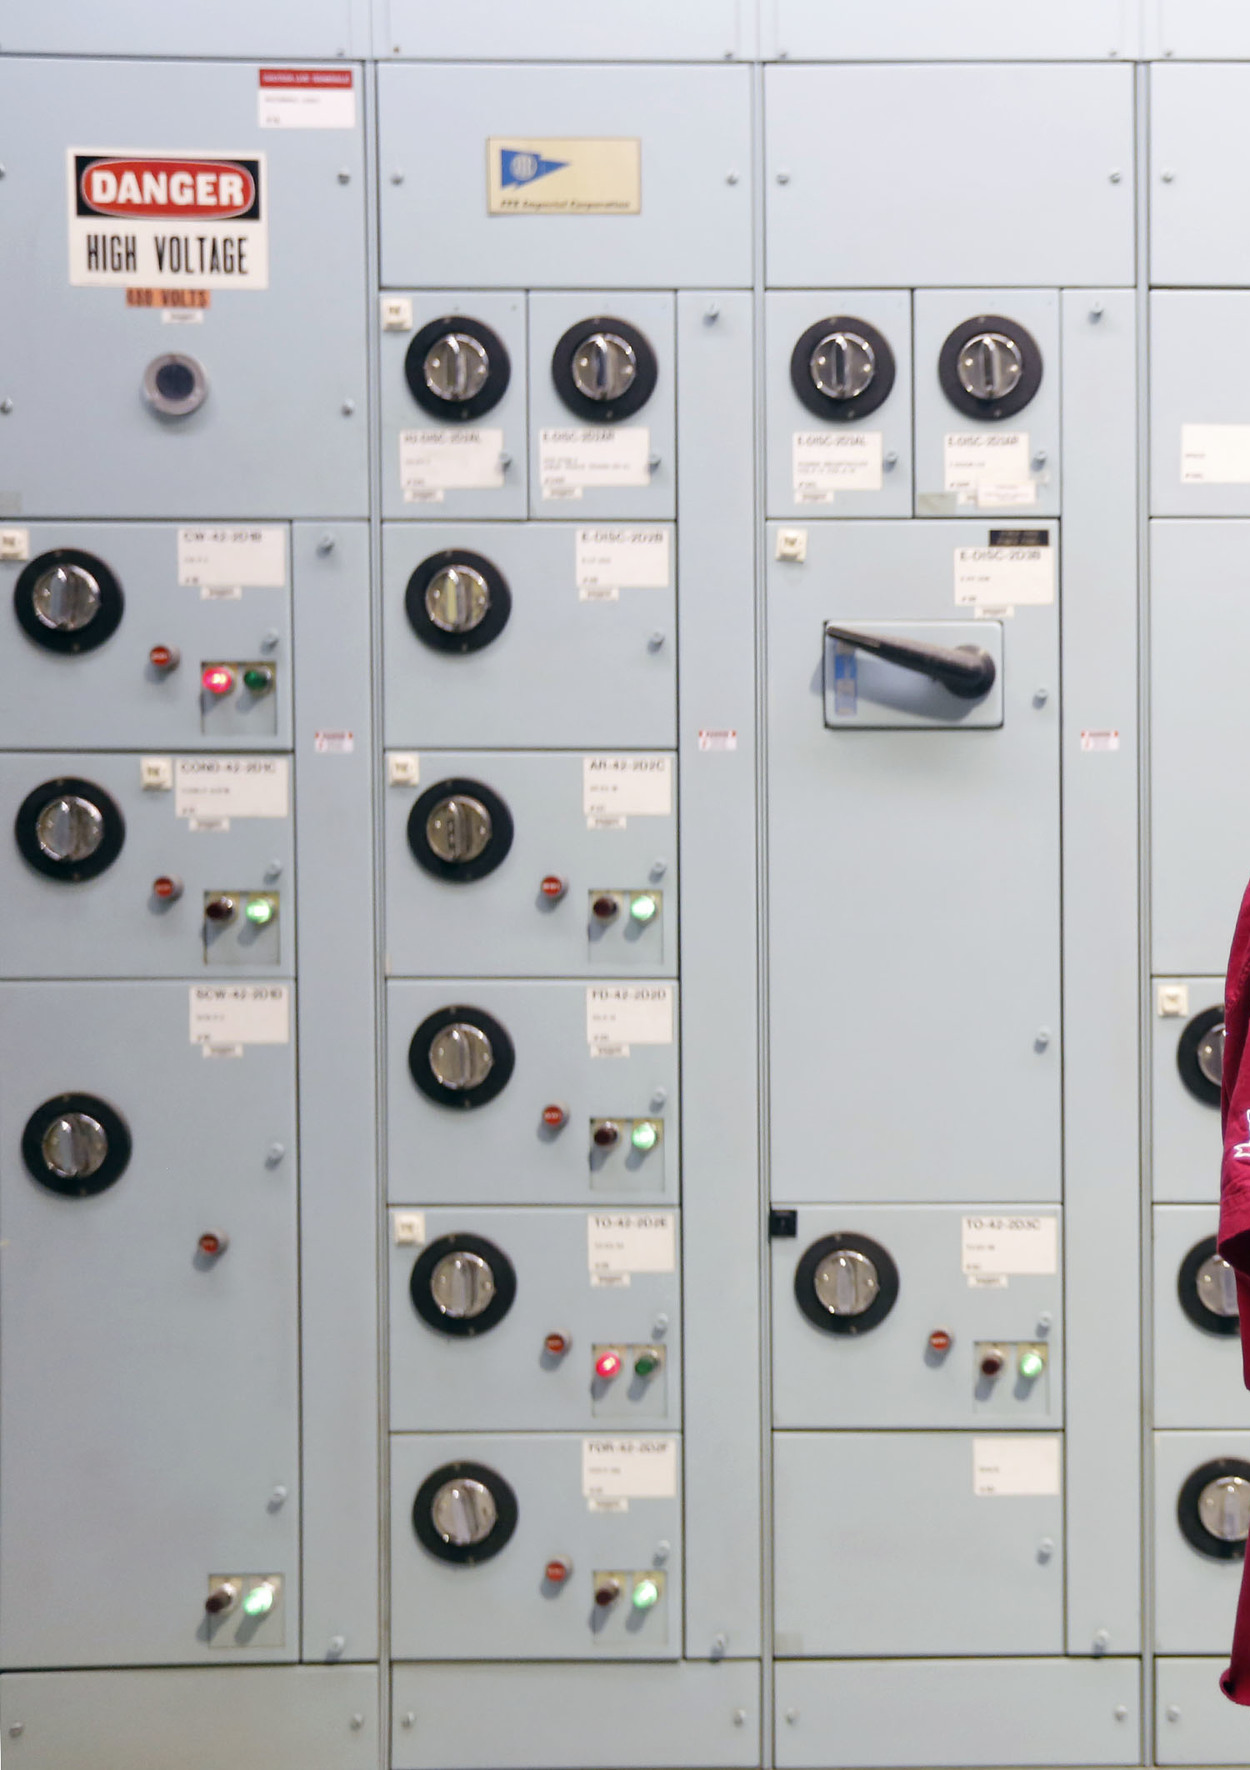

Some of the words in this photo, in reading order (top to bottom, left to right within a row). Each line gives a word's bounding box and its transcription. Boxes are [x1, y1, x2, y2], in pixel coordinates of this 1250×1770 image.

[91, 170, 245, 206] DANGER
[87, 234, 137, 273] HIGH
[154, 236, 248, 275] VOLTAGE
[160, 289, 206, 309] VOLTS
